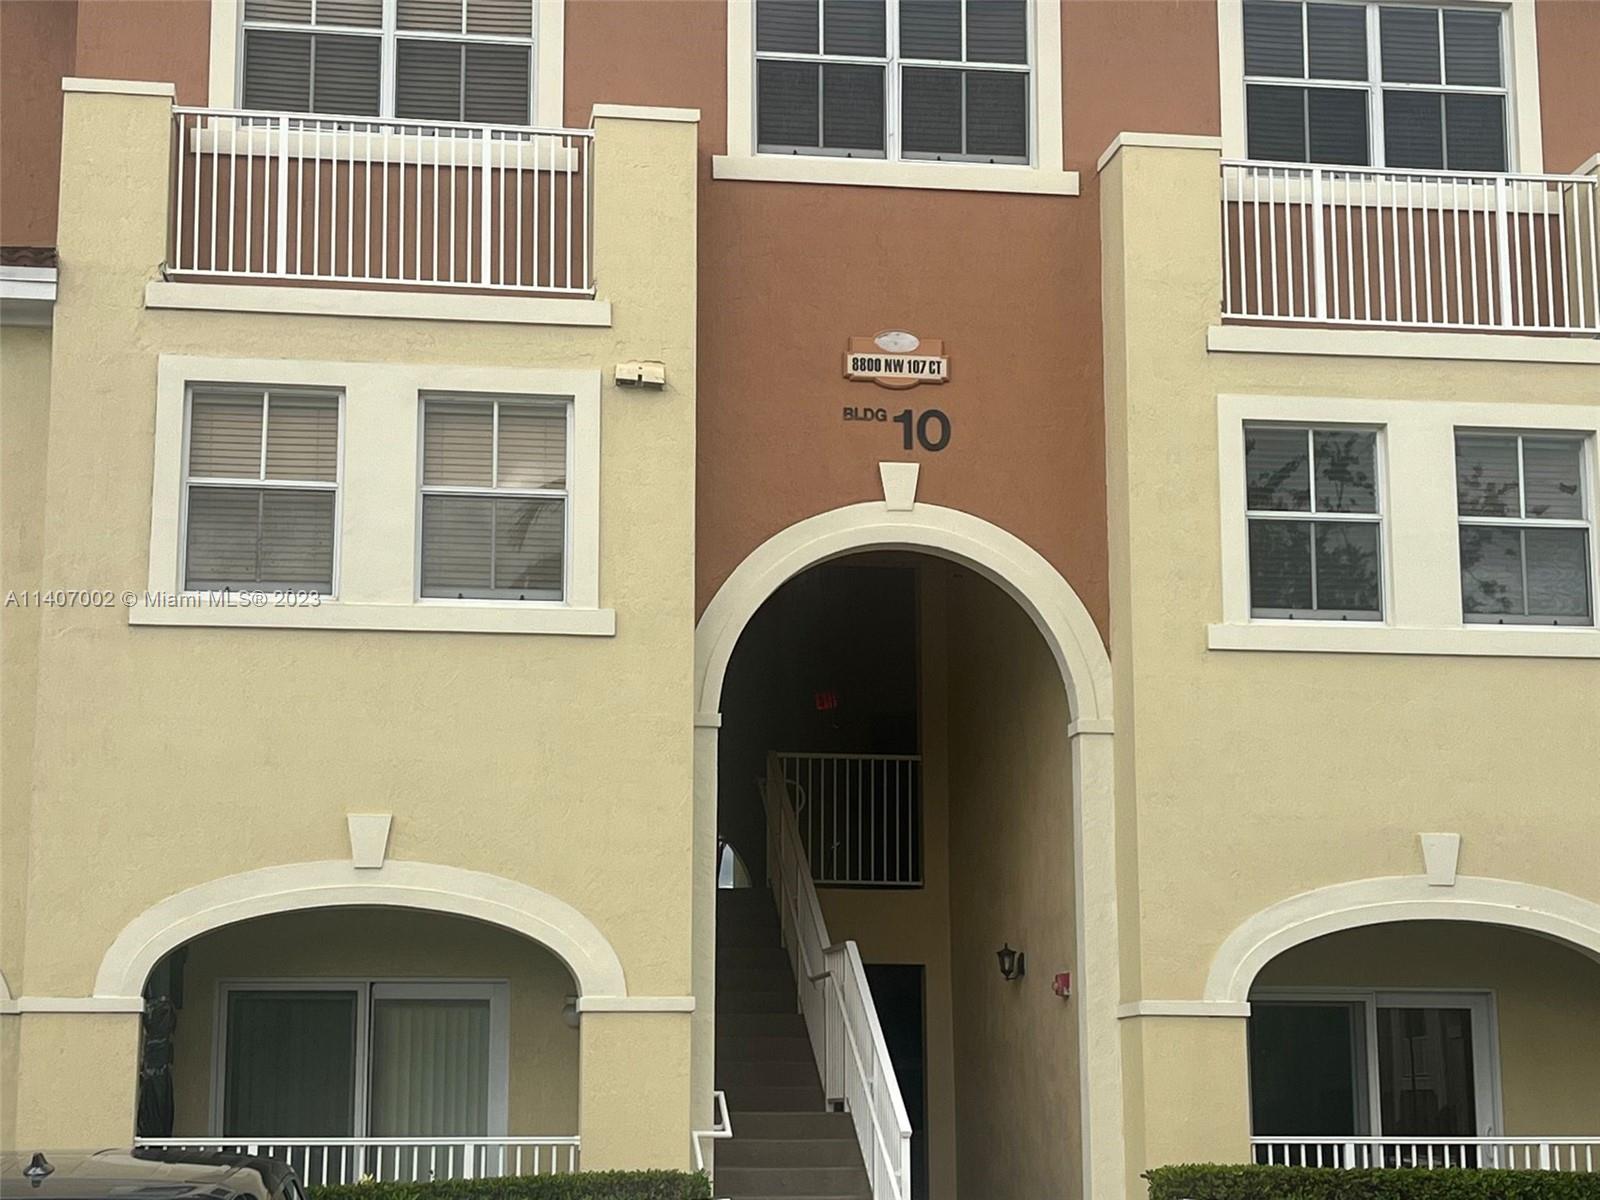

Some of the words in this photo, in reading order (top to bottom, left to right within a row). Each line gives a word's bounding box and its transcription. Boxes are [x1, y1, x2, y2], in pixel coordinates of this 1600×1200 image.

[852, 357, 881, 372] 8800
[884, 359, 904, 373] NW
[907, 360, 926, 374] 107
[928, 361, 942, 375] CT
[843, 407, 887, 421] BLDG
[893, 409, 951, 452] 10
